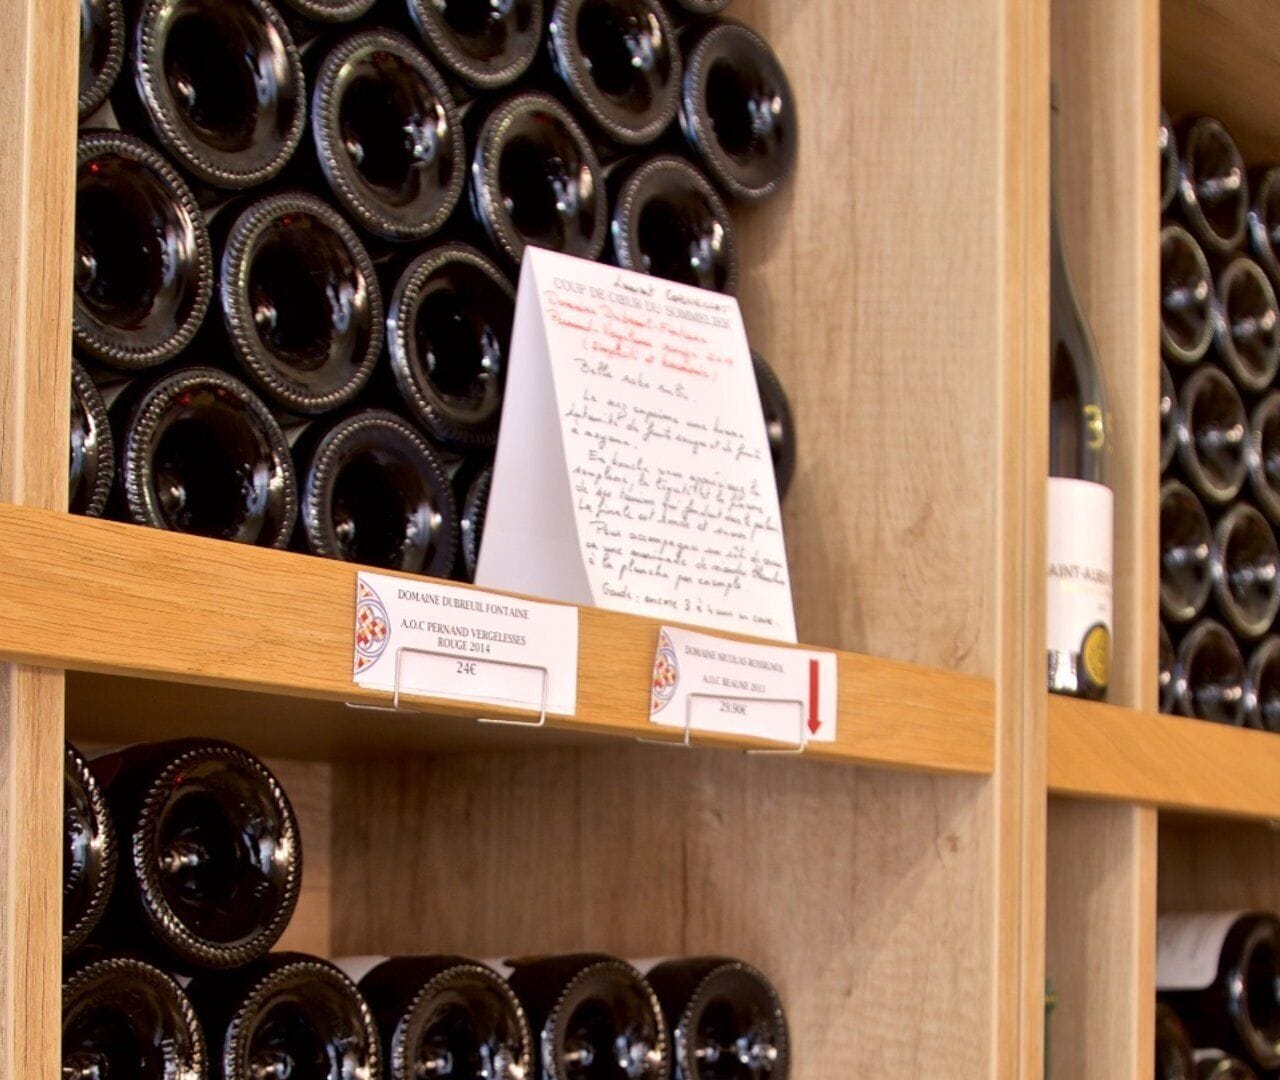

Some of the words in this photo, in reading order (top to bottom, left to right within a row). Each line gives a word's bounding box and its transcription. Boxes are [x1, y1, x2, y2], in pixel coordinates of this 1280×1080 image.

[397, 588, 440, 606] DOMAINE
[442, 596, 484, 613] DUBREUIL
[485, 604, 529, 620] FONTAINE
[427, 621, 469, 637] PERNAND
[471, 628, 527, 646] VERGELESSES
[437, 636, 468, 652] ROUGE
[469, 641, 491, 654] 2014
[456, 661, 477, 675] 24€
